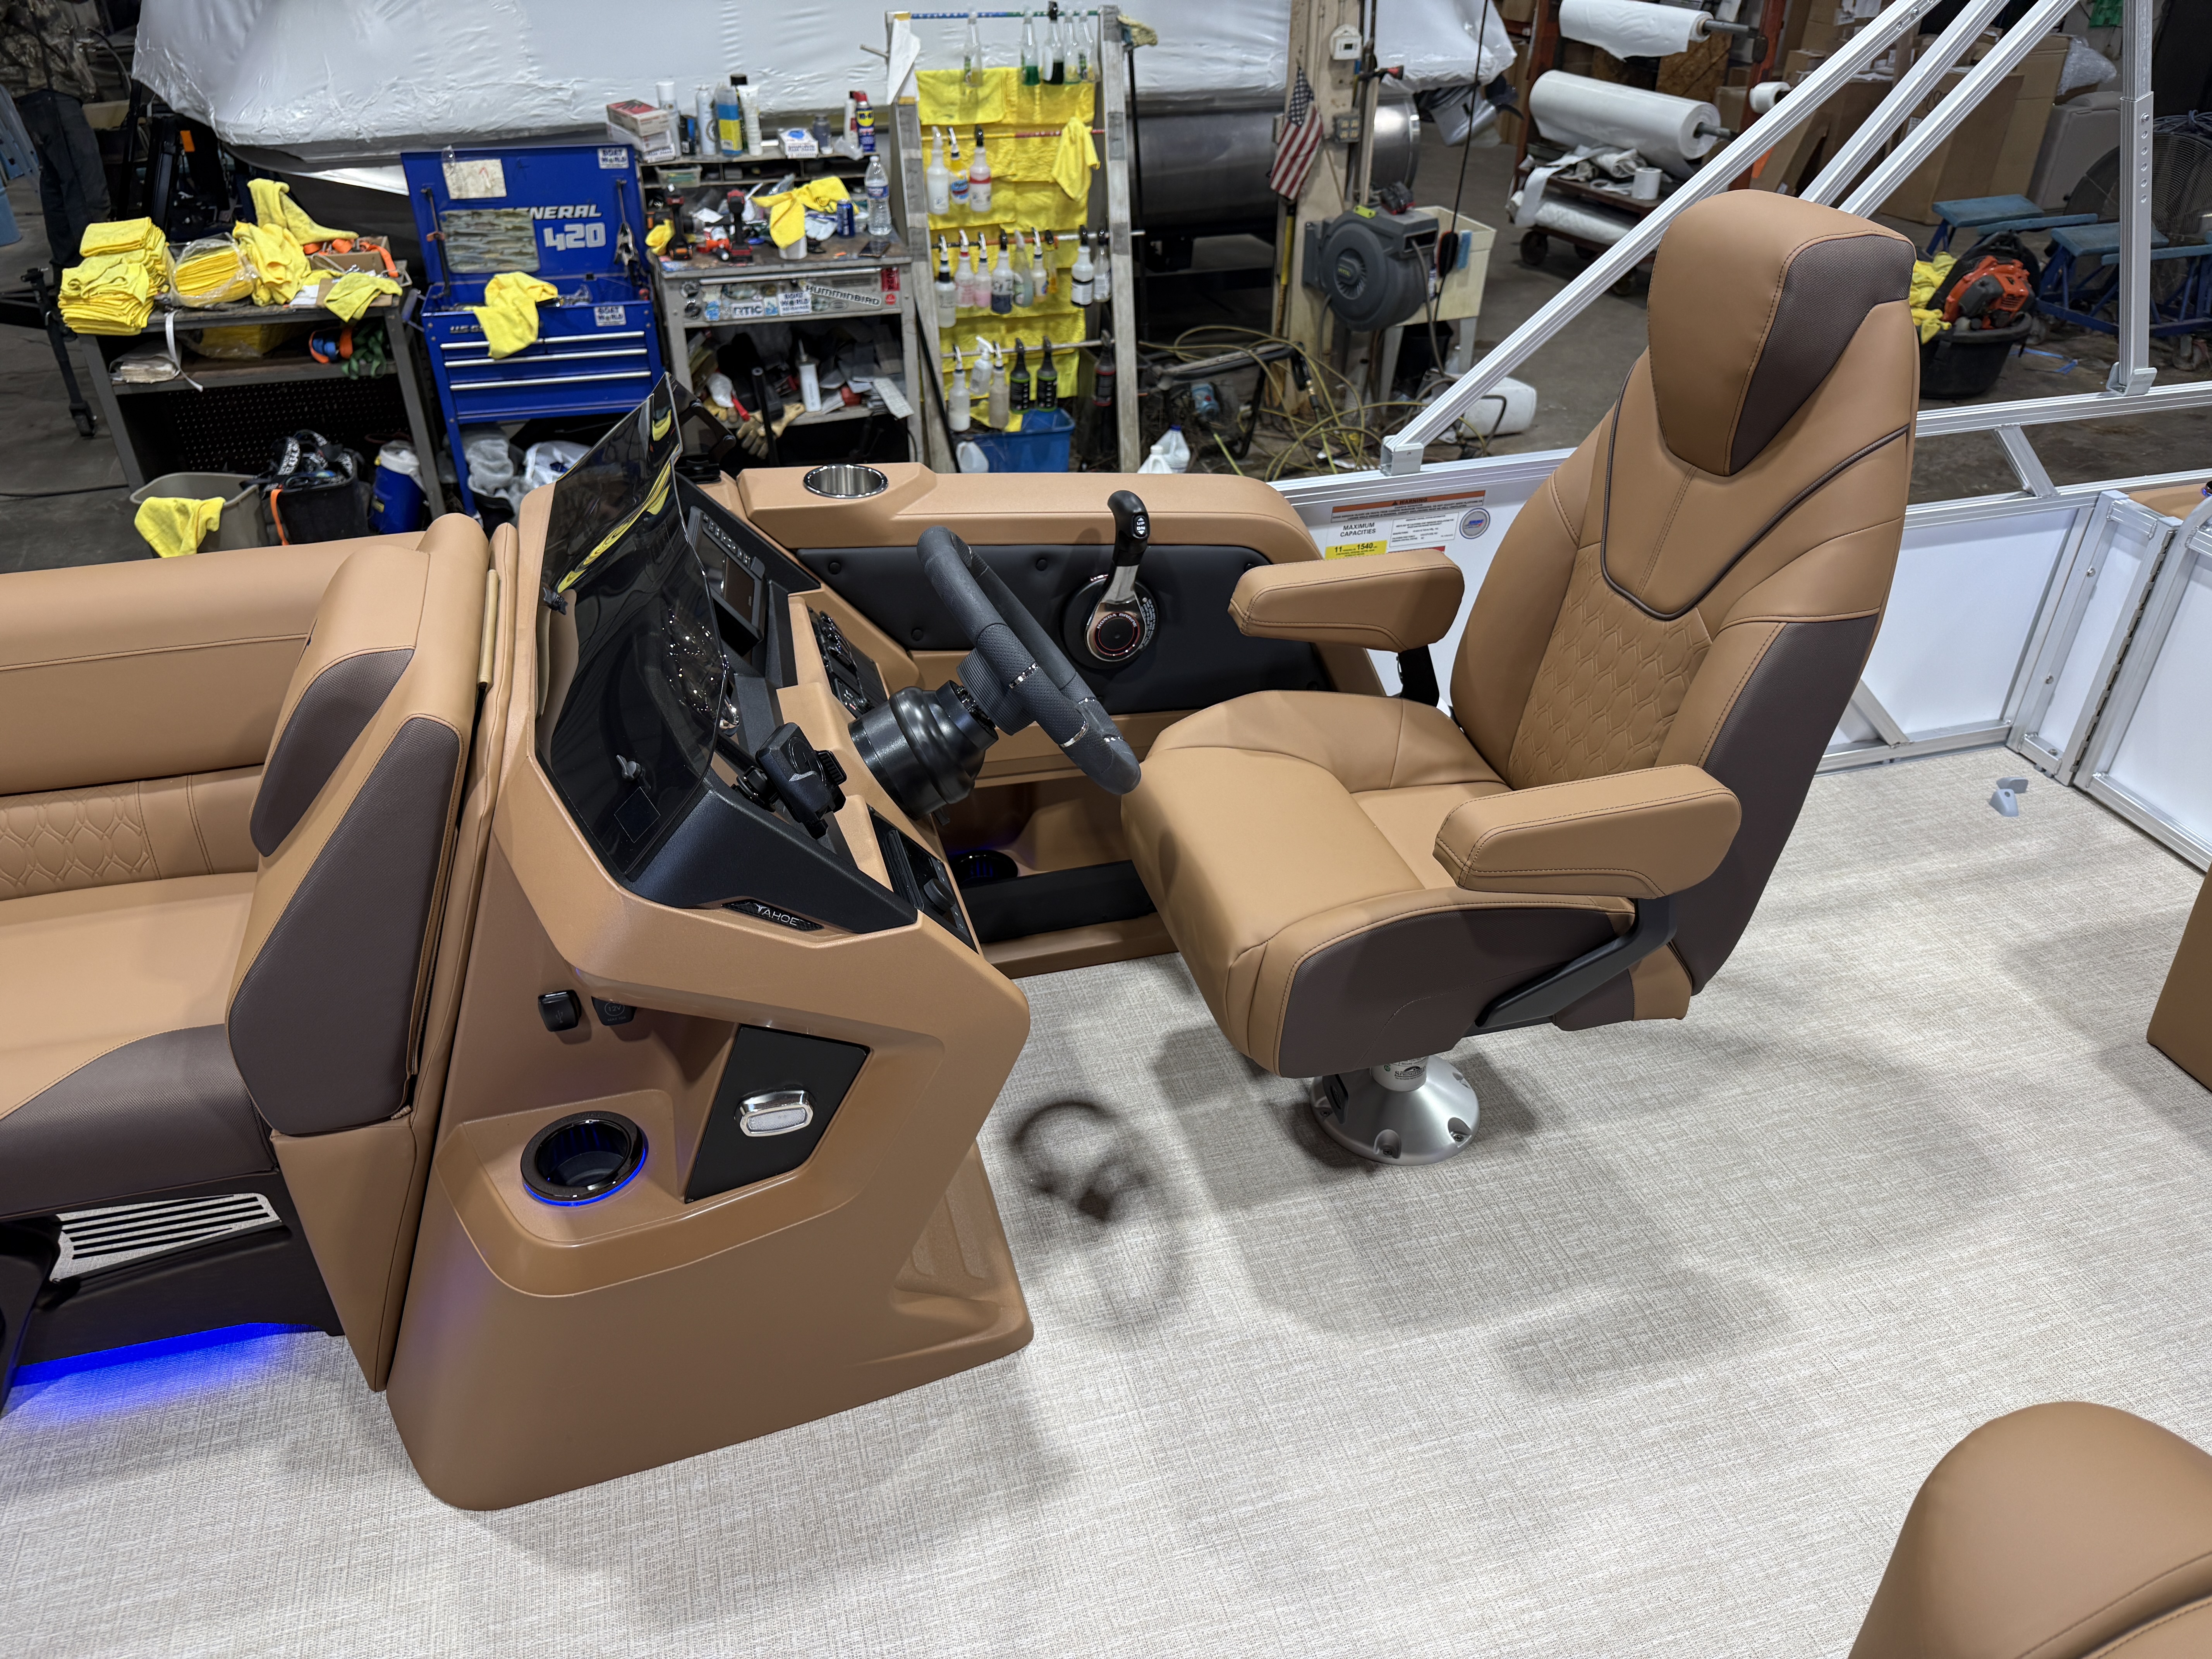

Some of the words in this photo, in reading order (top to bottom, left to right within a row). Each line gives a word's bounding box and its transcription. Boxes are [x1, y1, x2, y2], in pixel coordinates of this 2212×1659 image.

[543, 222, 606, 251] 420
[806, 285, 879, 305] HUMMINBIRD
[733, 306, 763, 316] RTIC
[1340, 528, 1376, 537] CAPACITIES
[1343, 522, 1375, 531] MAXIMUM
[1097, 613, 1117, 629] HONDA
[1118, 613, 1137, 628] MARINE
[753, 903, 800, 926] TAHOE
[1395, 1065, 1426, 1076] SPRINGFIELD
